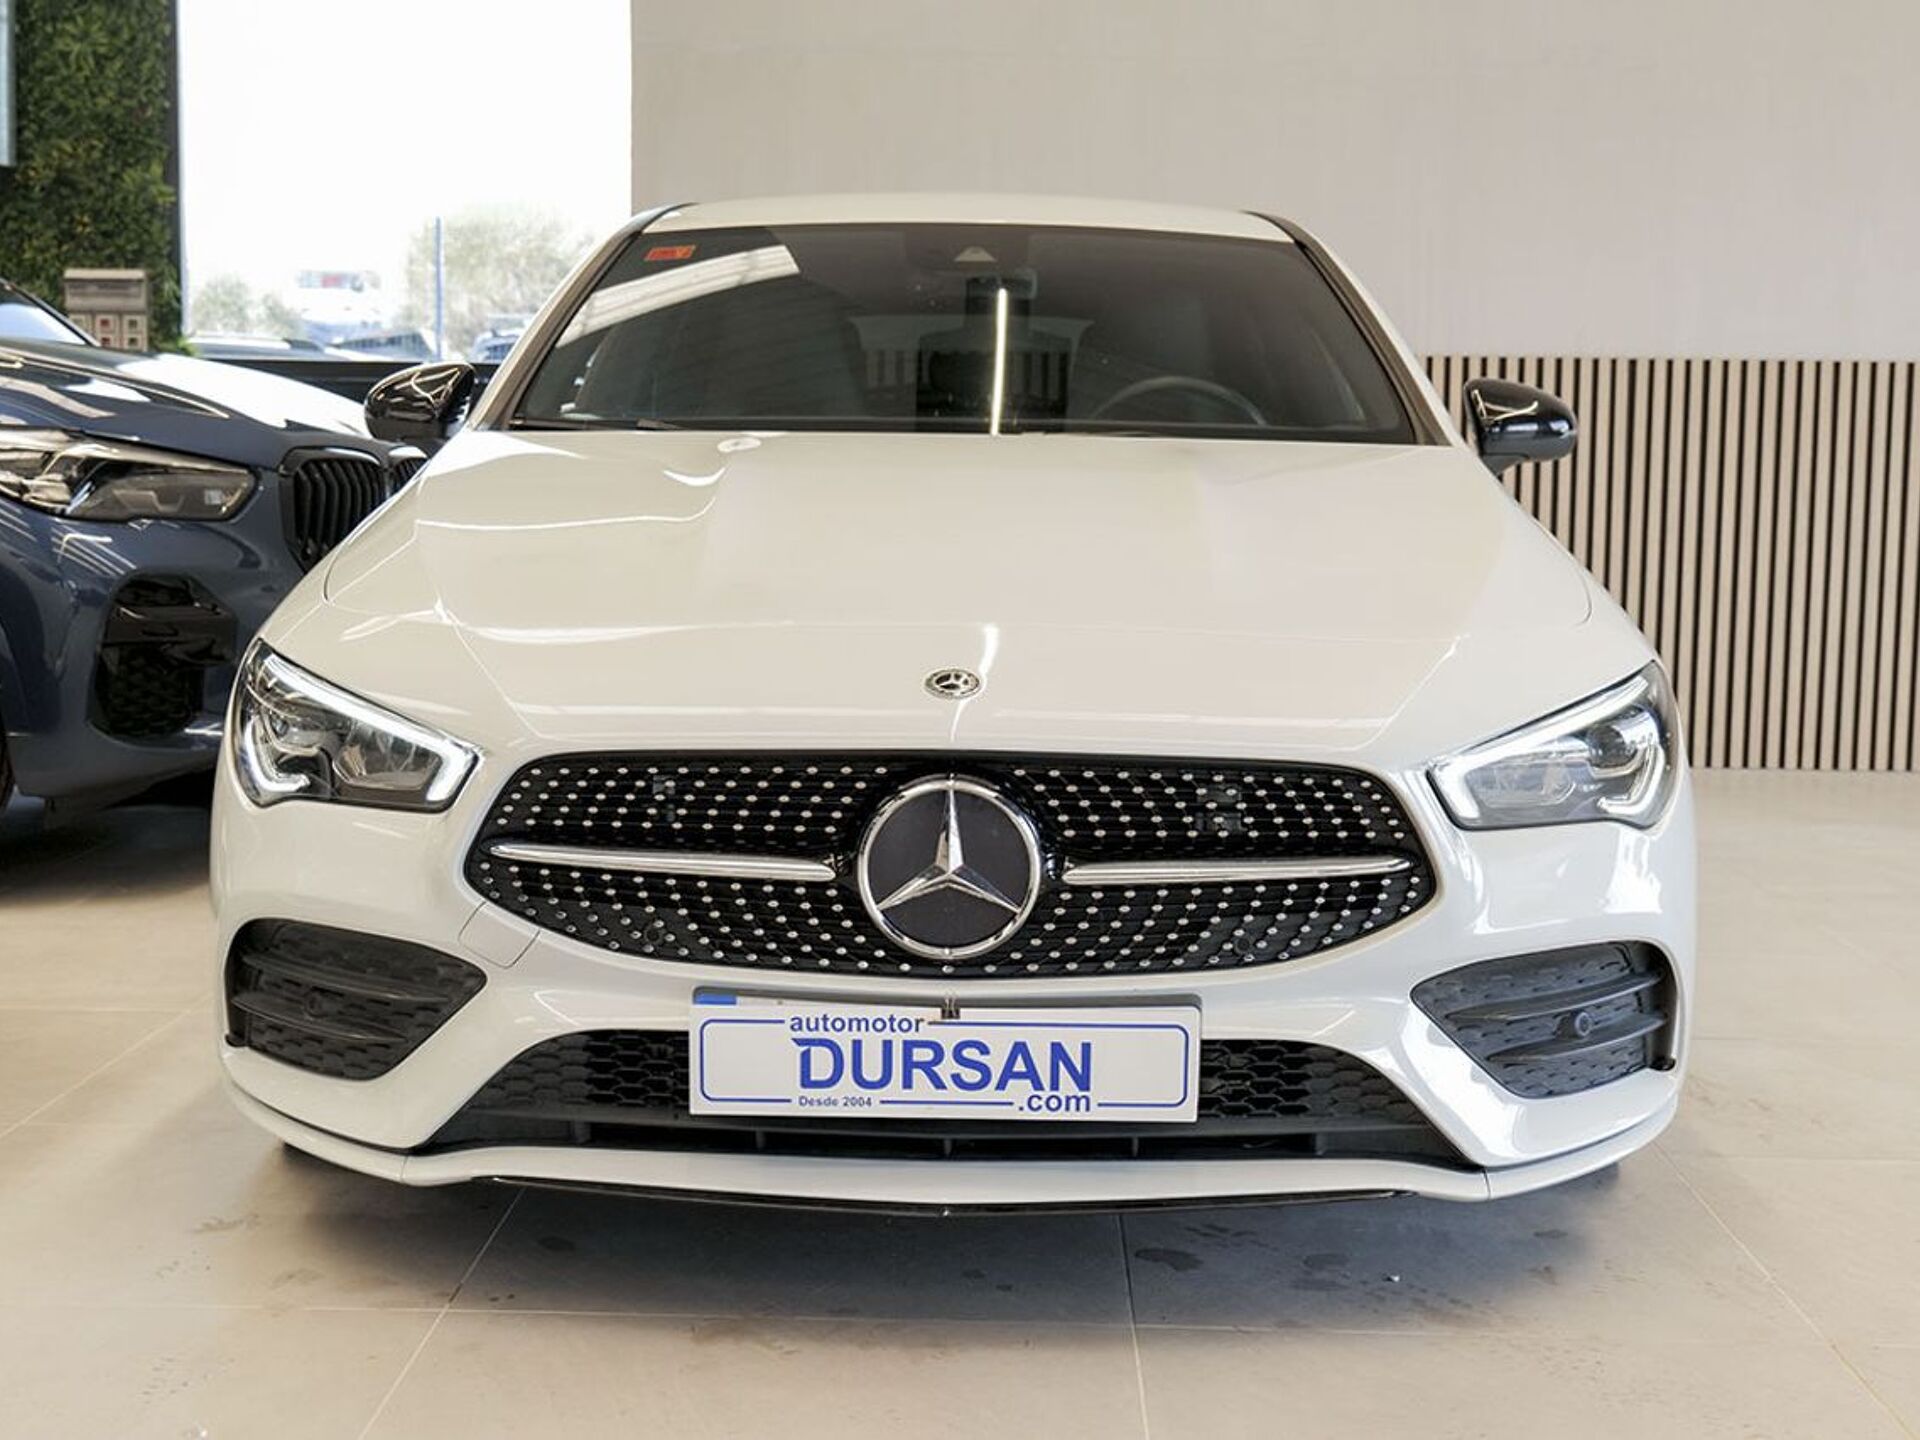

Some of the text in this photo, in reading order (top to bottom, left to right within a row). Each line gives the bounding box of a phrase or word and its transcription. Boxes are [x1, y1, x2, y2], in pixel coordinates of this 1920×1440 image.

[789, 1014, 924, 1034] automotor
[792, 1037, 1092, 1093] DURSAN
[798, 1095, 873, 1108] Desde 2004
[1017, 1091, 1092, 1113] .com
